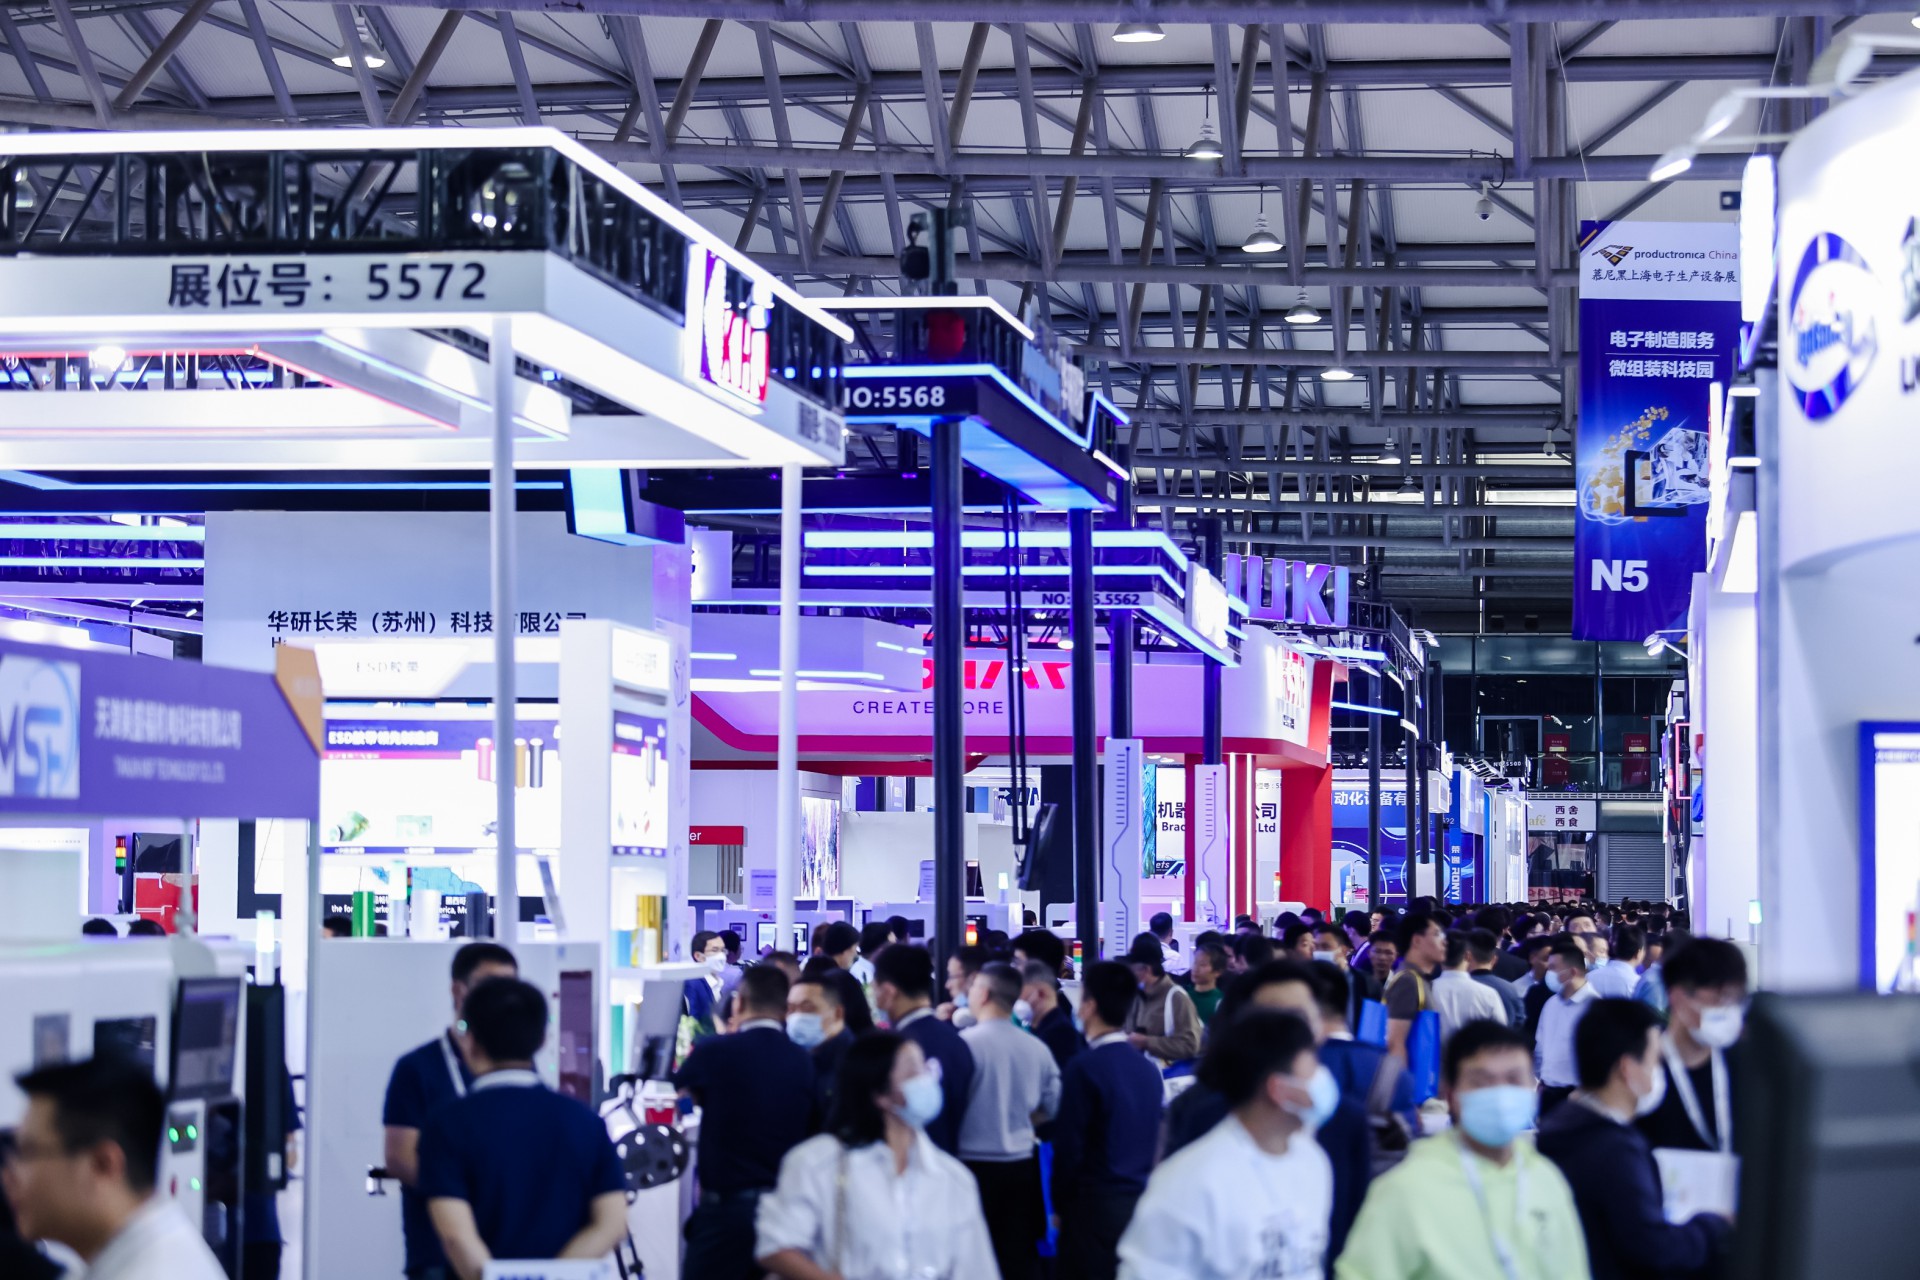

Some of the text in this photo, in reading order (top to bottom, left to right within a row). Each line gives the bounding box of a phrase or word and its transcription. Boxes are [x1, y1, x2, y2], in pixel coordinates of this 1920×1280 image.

[1634, 250, 1738, 261] productronica China
[367, 262, 486, 301] 5572
[1609, 330, 1715, 349] 电子制造服务
[1609, 359, 1714, 378] 微组装科技园
[1591, 558, 1649, 592] N5
[267, 610, 587, 633] 华研长荣（苏州）科技限公
[963, 701, 1003, 714] ORE
[1157, 801, 1277, 819] 机器 司
[1528, 814, 1547, 826] afé
